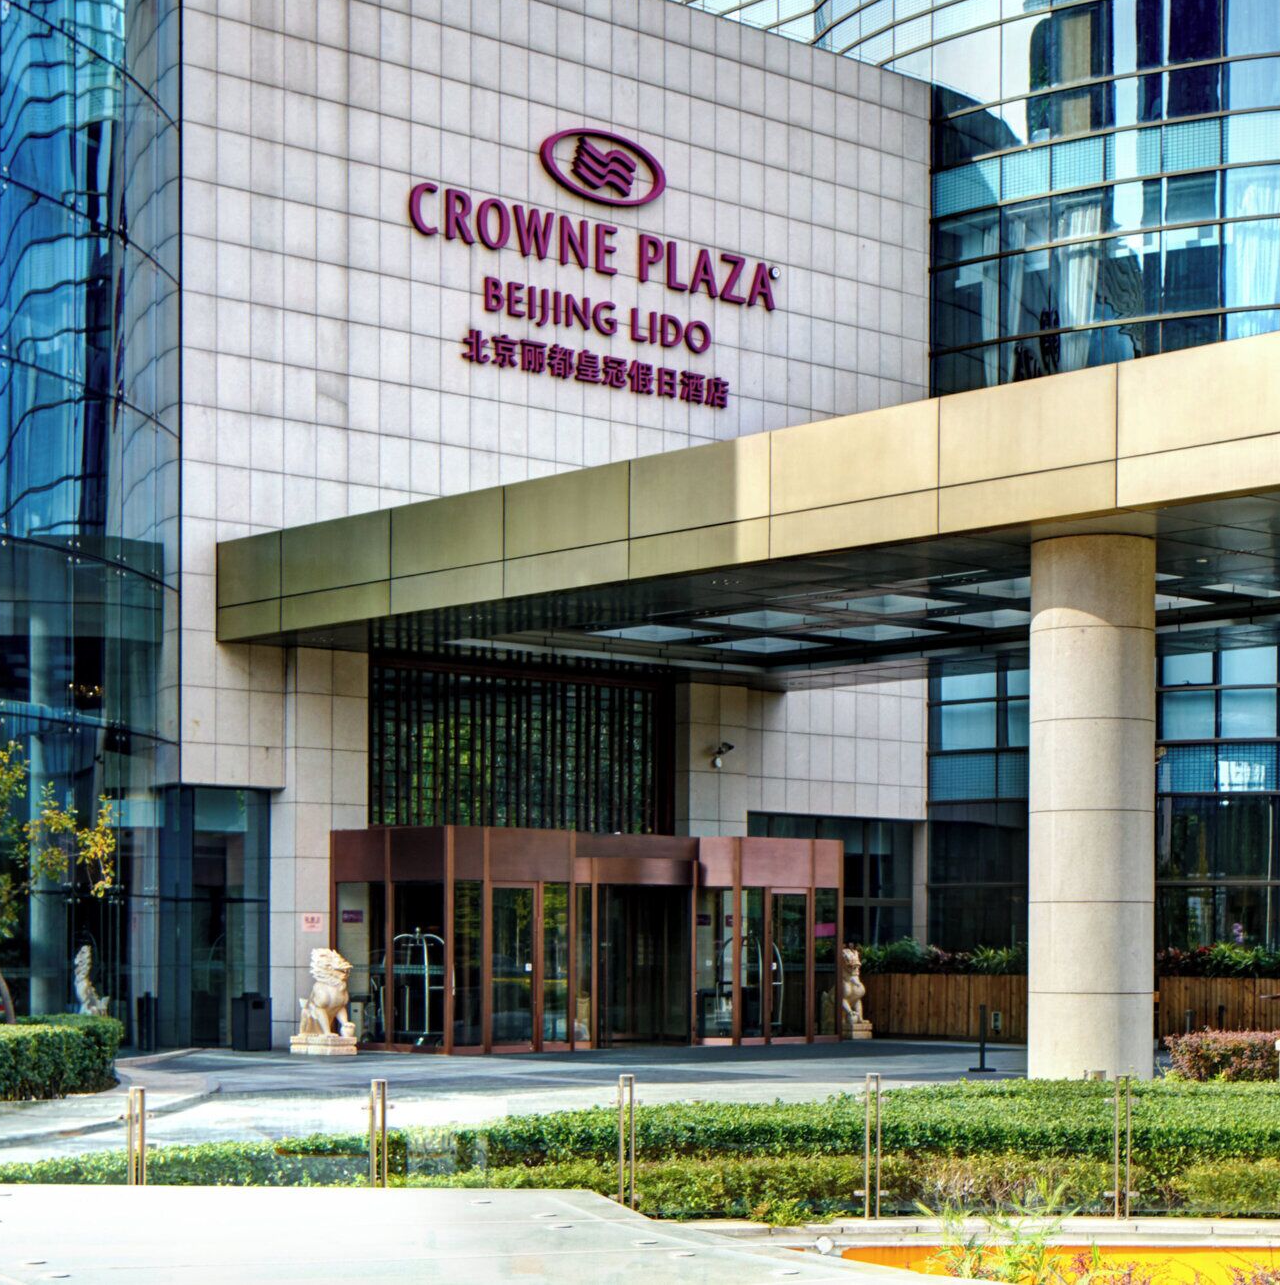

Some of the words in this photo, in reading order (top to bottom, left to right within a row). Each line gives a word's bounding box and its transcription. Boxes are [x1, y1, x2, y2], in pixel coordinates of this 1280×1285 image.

[408, 181, 619, 276] CROWNE
[638, 233, 776, 312] PLAZA
[484, 275, 619, 337] BEIJING
[630, 306, 712, 355] LIDO
[461, 328, 730, 409] 北京丽都皇冠假日酒店
